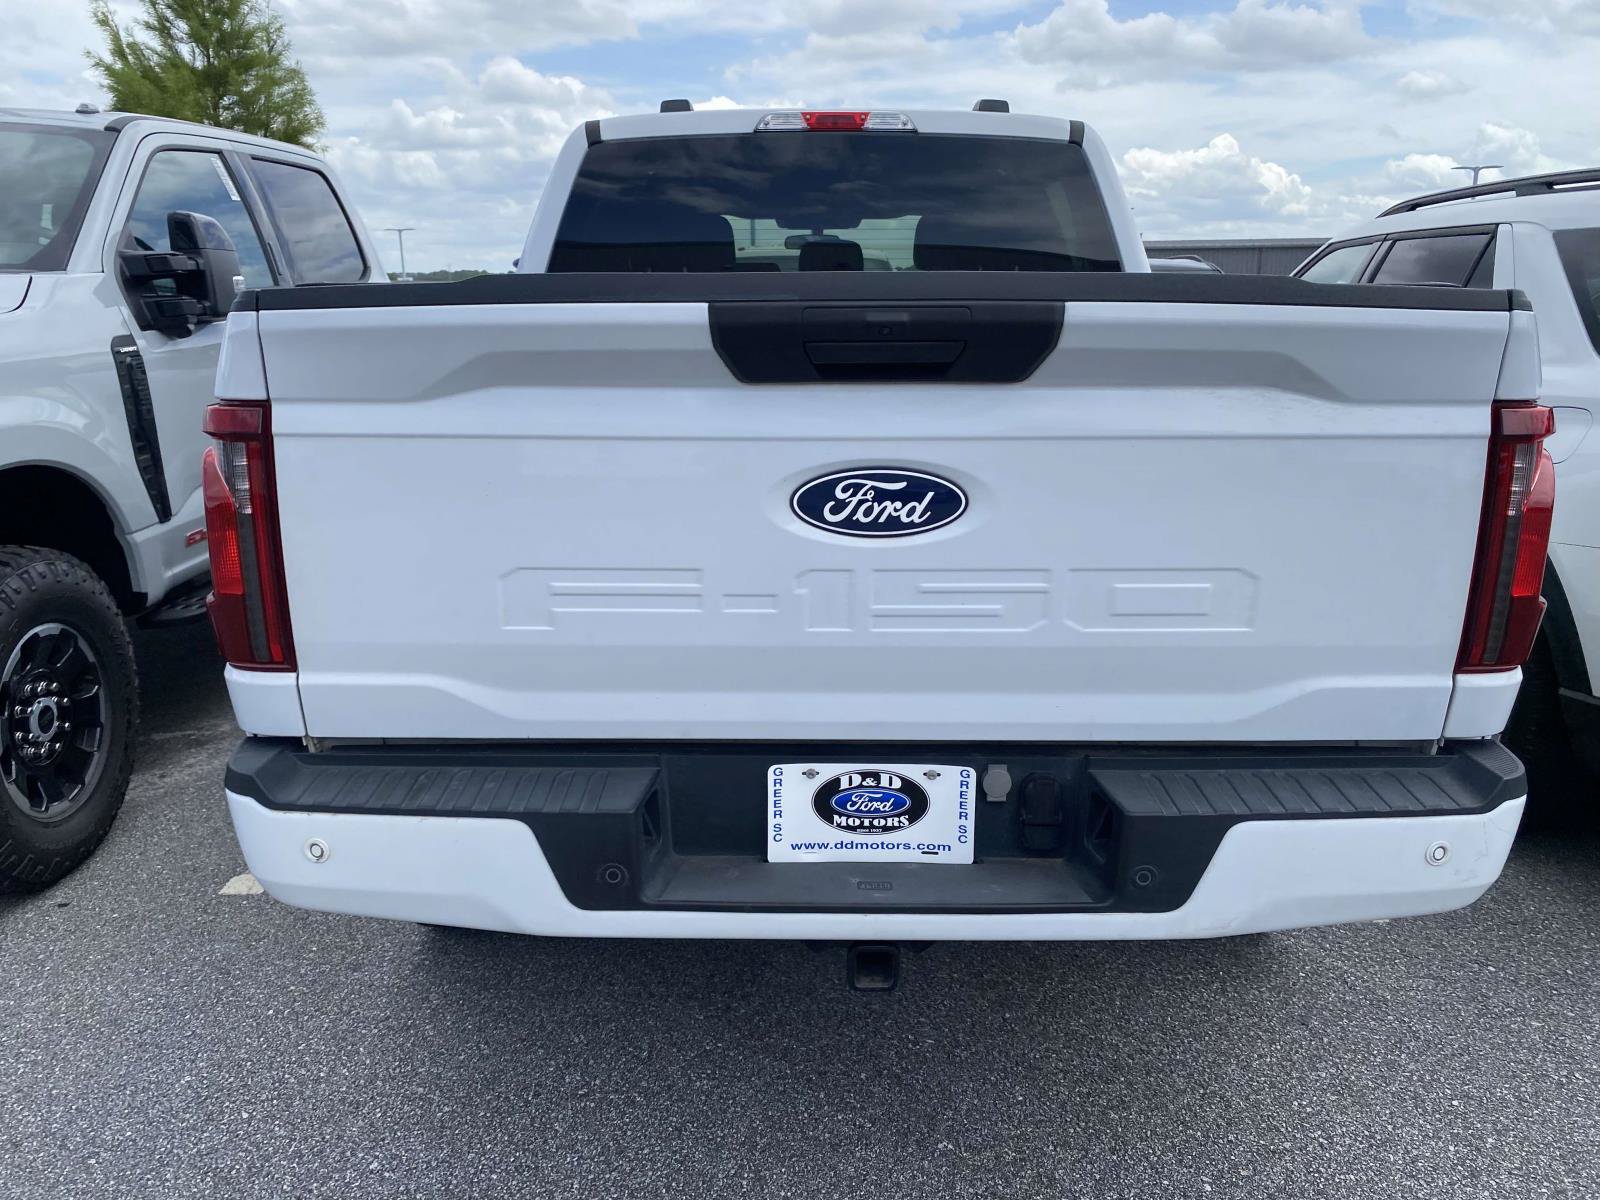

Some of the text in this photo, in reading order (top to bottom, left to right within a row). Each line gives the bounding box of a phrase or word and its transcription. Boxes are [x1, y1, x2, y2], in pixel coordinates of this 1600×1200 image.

[822, 477, 936, 525] Ford
[499, 566, 1261, 632] F-150
[839, 772, 902, 790] D&D
[773, 767, 783, 843] GREER SC
[846, 792, 894, 812] Ford
[958, 769, 971, 844] GREER SC
[833, 814, 910, 827] MOTORS
[790, 840, 952, 852] www.ddmotors.com
